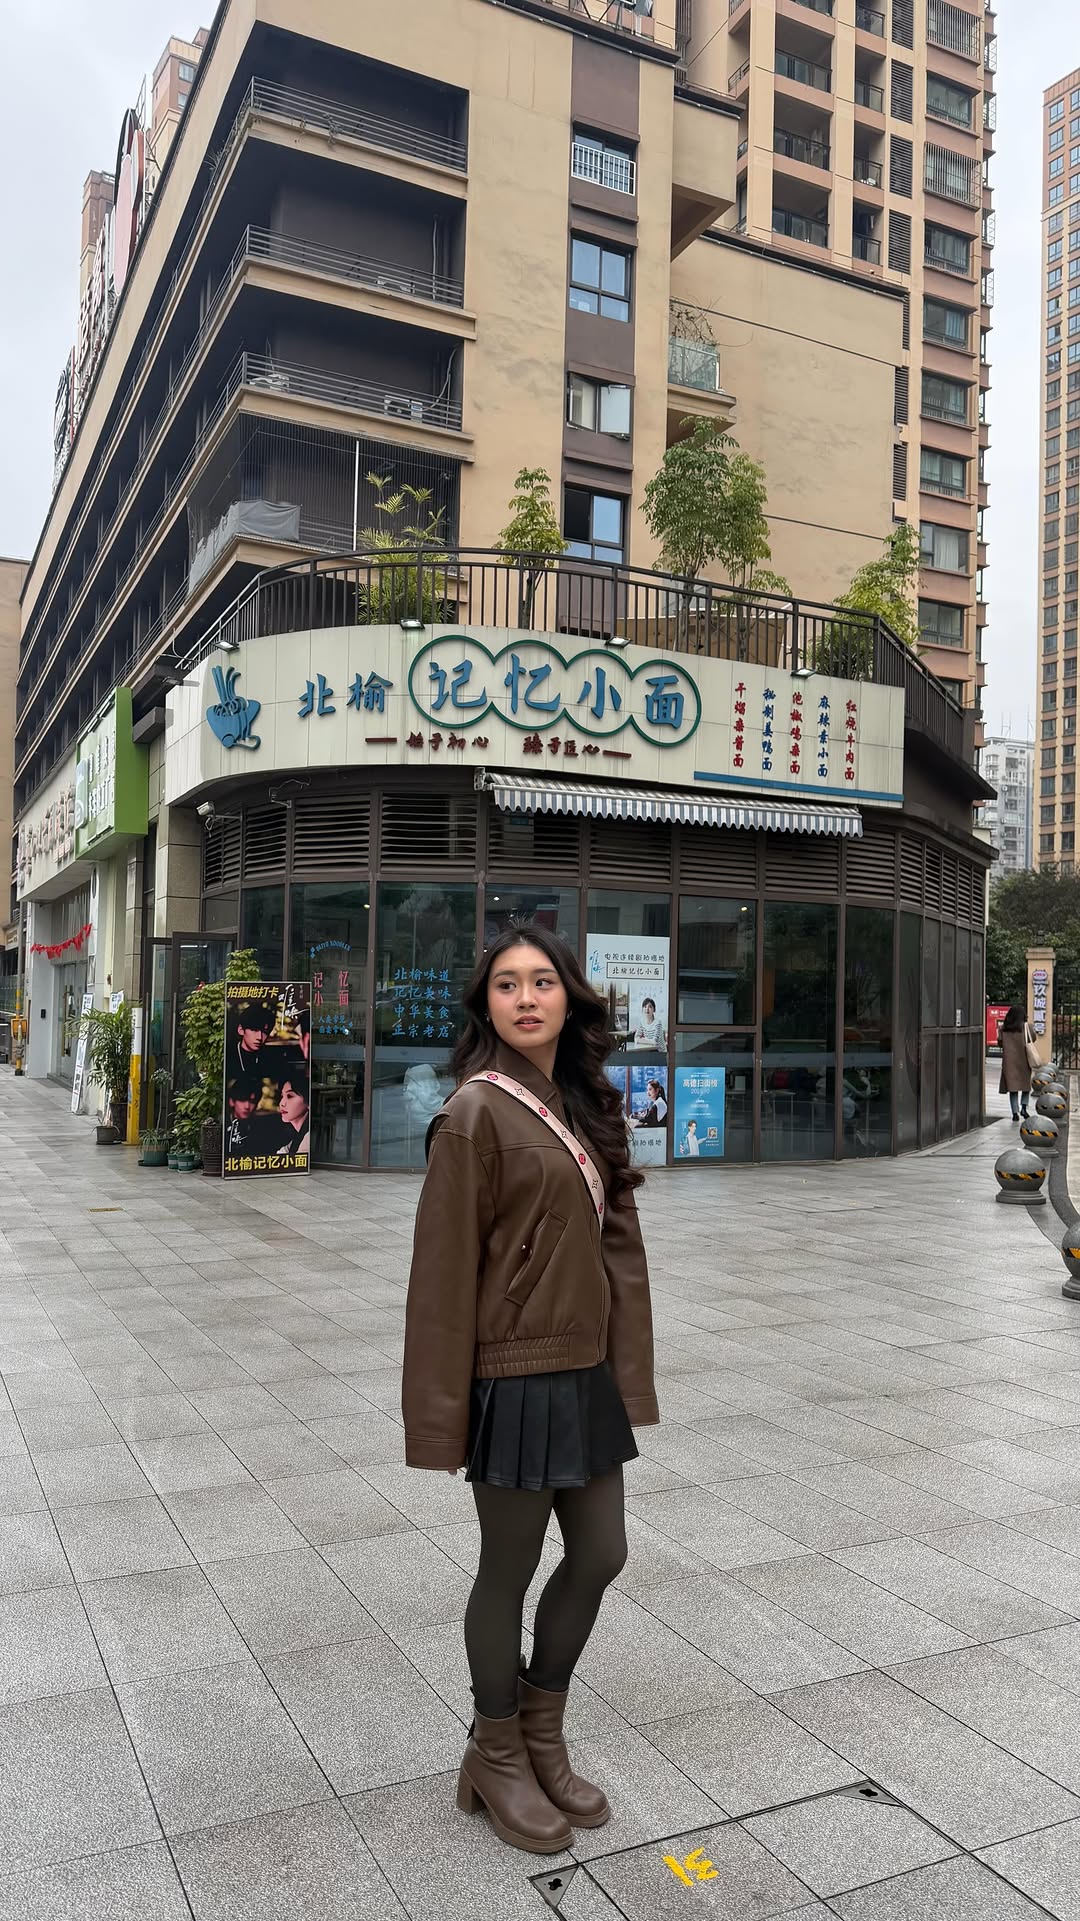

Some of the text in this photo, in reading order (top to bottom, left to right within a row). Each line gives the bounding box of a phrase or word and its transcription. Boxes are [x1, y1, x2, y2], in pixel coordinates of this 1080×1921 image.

[297, 653, 684, 729] 北榆 记忆小面
[845, 699, 857, 781] 红烧牛肉面
[394, 967, 451, 982] 北榆味道
[227, 985, 279, 999] 拍摄地打卡
[394, 986, 452, 1000] 记忆美味
[394, 1004, 450, 1020] 中华美食
[392, 1024, 449, 1039] 正宗老店
[225, 1154, 308, 1172] 北榆记忆小面
